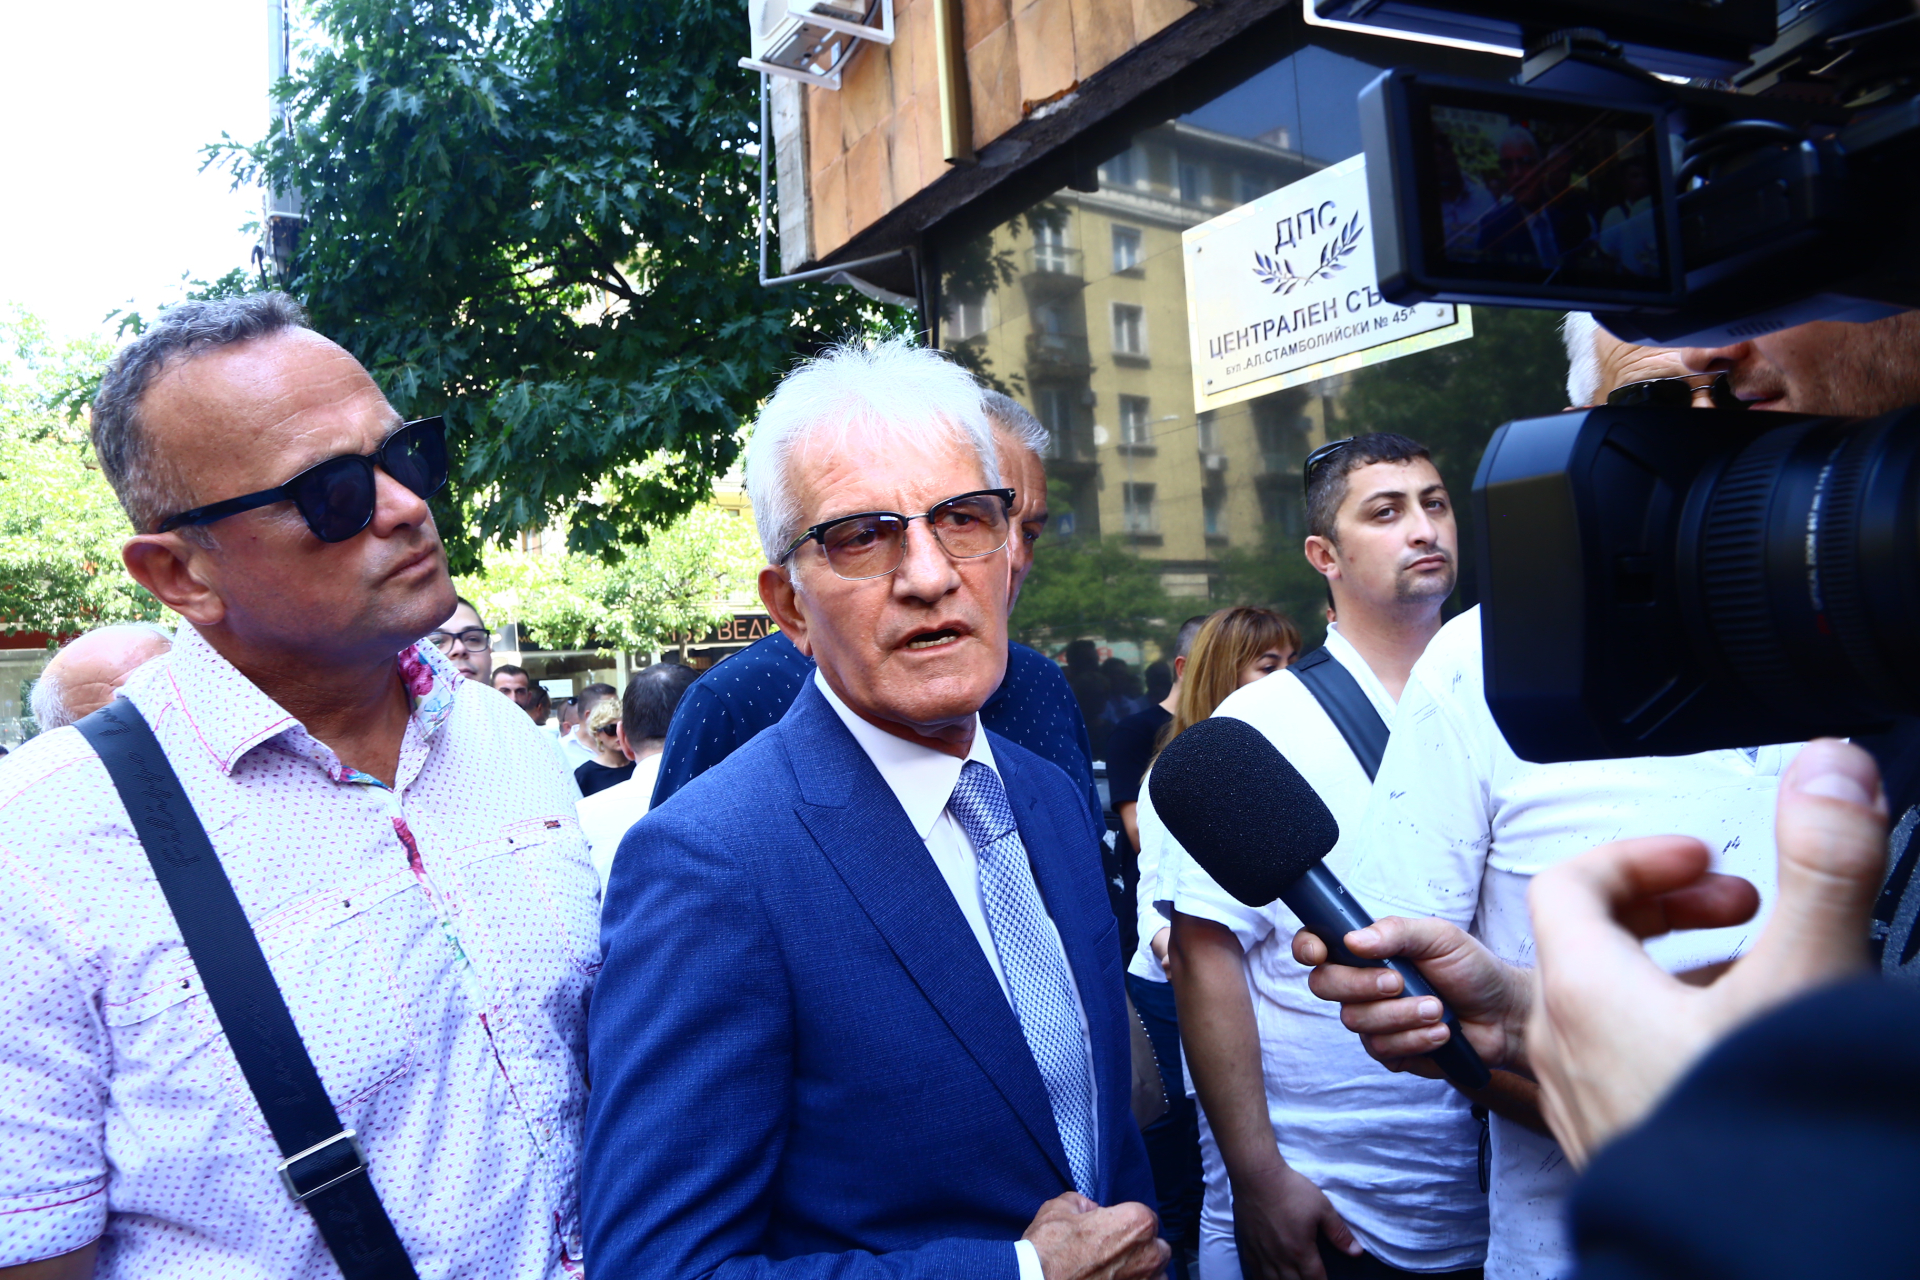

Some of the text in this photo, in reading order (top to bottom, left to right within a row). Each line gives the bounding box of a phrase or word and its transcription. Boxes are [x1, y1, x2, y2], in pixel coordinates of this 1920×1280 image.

[1275, 200, 1337, 255] ДПС
[1209, 285, 1383, 360] ЦЕНТРАЛЕН СЪ
